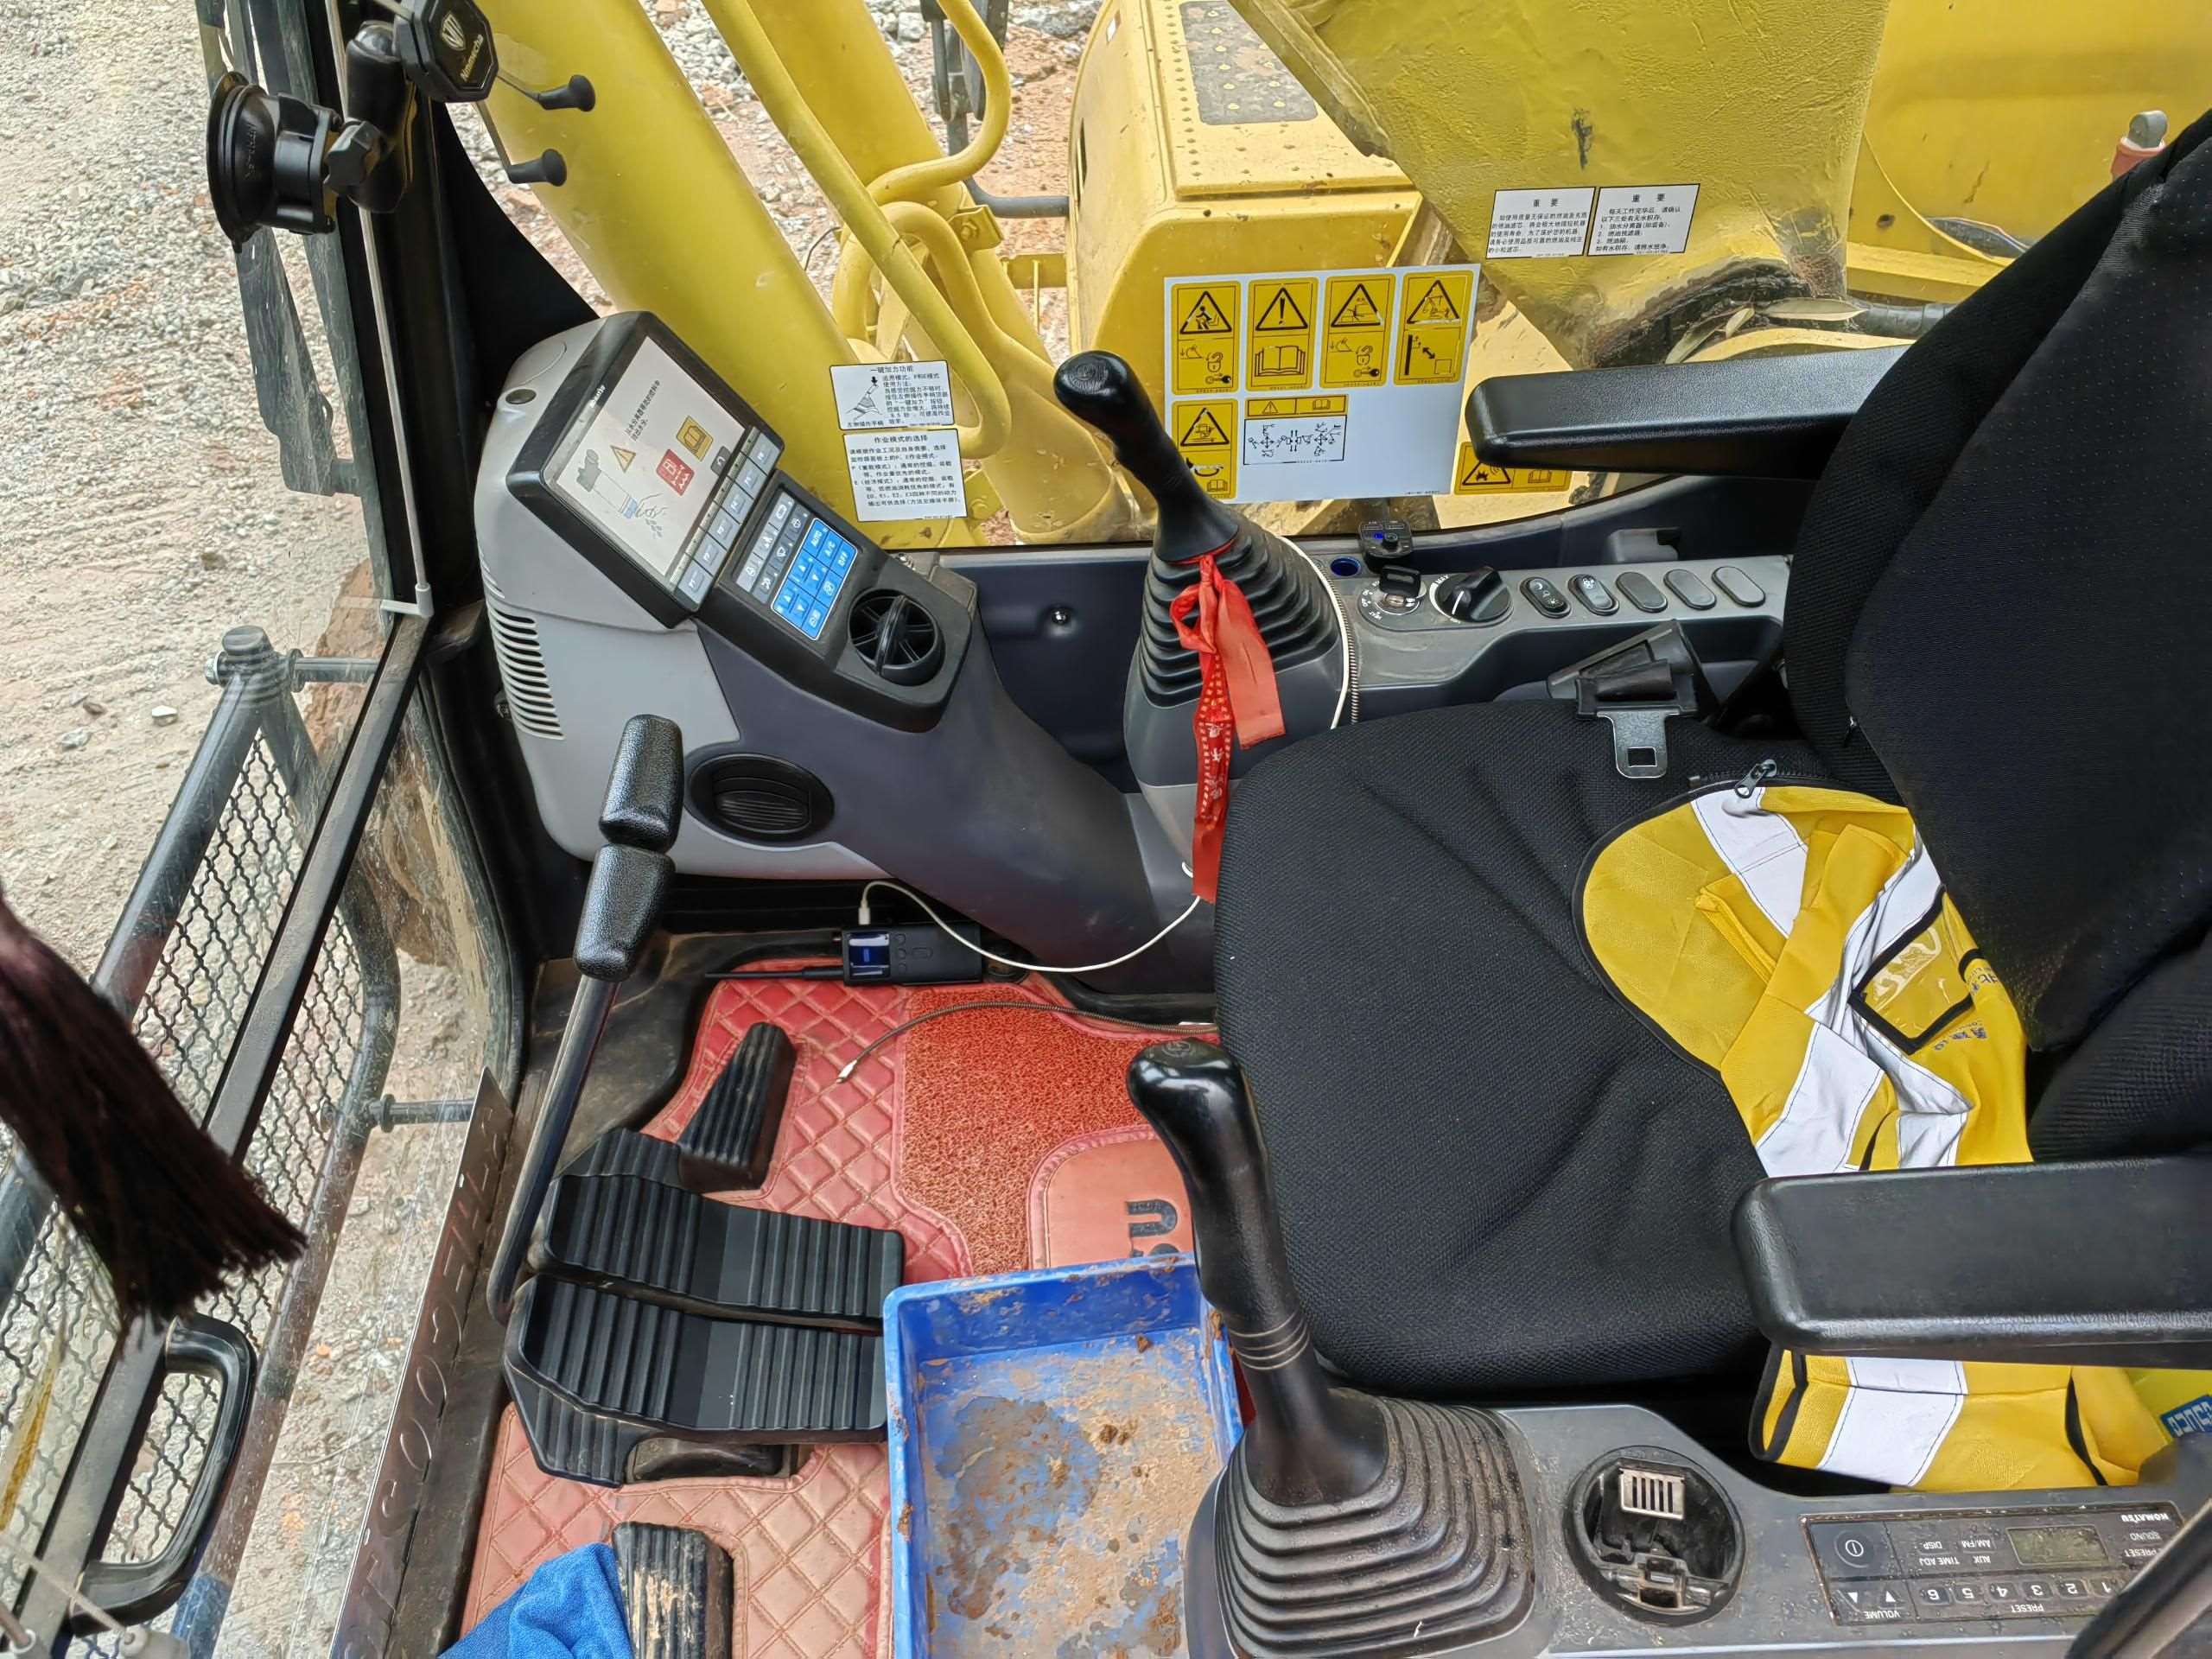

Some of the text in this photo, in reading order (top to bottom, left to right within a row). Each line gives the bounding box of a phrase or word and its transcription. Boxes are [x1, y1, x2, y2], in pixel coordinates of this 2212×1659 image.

[873, 434, 928, 443] 作业模式的选择
[823, 540, 836, 557] A/C
[2120, 1513, 2170, 1523] KOMATSU
[2129, 1530, 2161, 1541] SOUND
[1961, 1540, 1992, 1549] AM/FM
[2124, 1548, 2158, 1558] PRESET
[1919, 1557, 1961, 1567] TIME ADJ
[1971, 1556, 1992, 1565] AUX
[1996, 1586, 2009, 1598] 4
[2031, 1585, 2044, 1597] 3
[2065, 1583, 2079, 1595] 2
[2101, 1581, 2112, 1594] 1
[1927, 1589, 1941, 1601] 6
[1961, 1587, 1975, 1599] 5
[2011, 1604, 2045, 1614] PRESET
[1863, 1610, 1902, 1619] VOLUME
